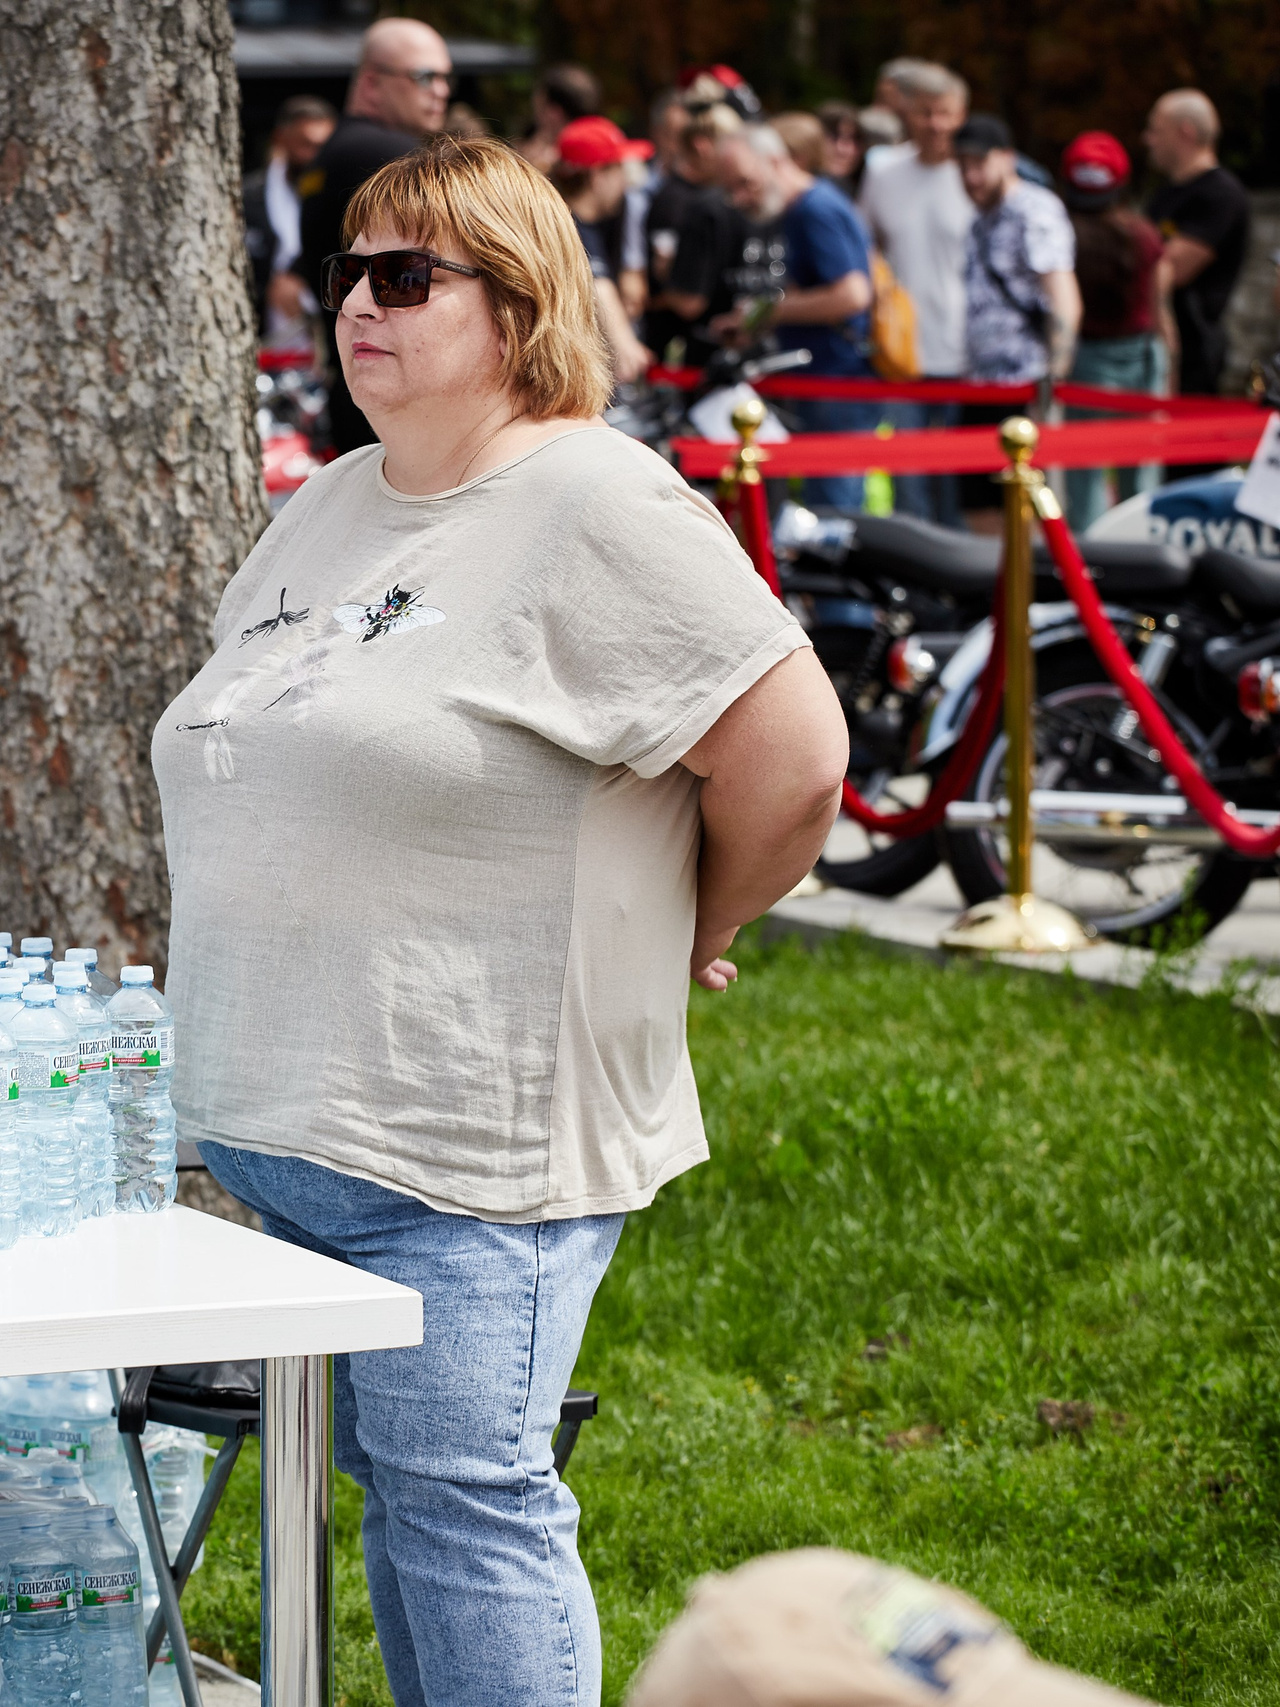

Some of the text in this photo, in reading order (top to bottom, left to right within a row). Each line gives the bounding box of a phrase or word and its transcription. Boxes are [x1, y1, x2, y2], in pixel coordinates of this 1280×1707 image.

[111, 1036, 157, 1048] НЕЖСКАЯ
[17, 1577, 71, 1595] СЕНЕЖСКАЯ
[84, 1571, 137, 1589] СЕНЕЖСКАЯ
